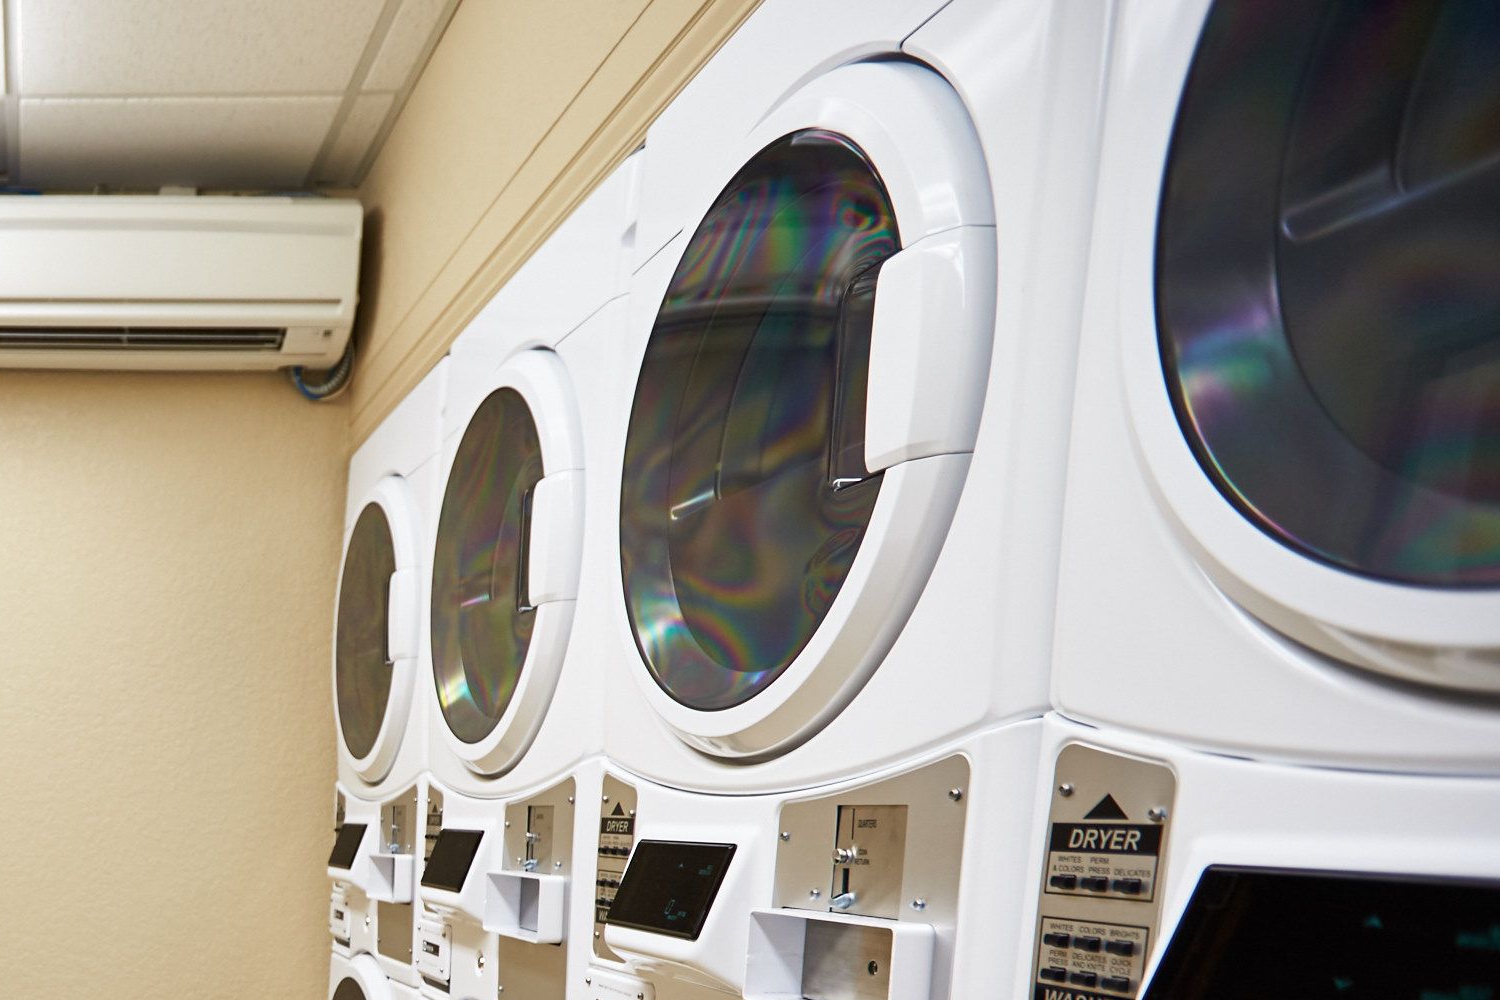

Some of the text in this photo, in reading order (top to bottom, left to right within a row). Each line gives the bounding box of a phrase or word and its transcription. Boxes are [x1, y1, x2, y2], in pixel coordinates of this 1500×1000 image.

[606, 820, 629, 832] DRYER
[1068, 828, 1141, 851] DRYER
[1058, 865, 1085, 873] COLORS
[1088, 866, 1111, 875] PRESS
[1114, 868, 1152, 878] DELICATES
[1049, 922, 1074, 932] WHITES
[1079, 926, 1106, 936] COLORS
[1109, 965, 1131, 976] CYCLE
